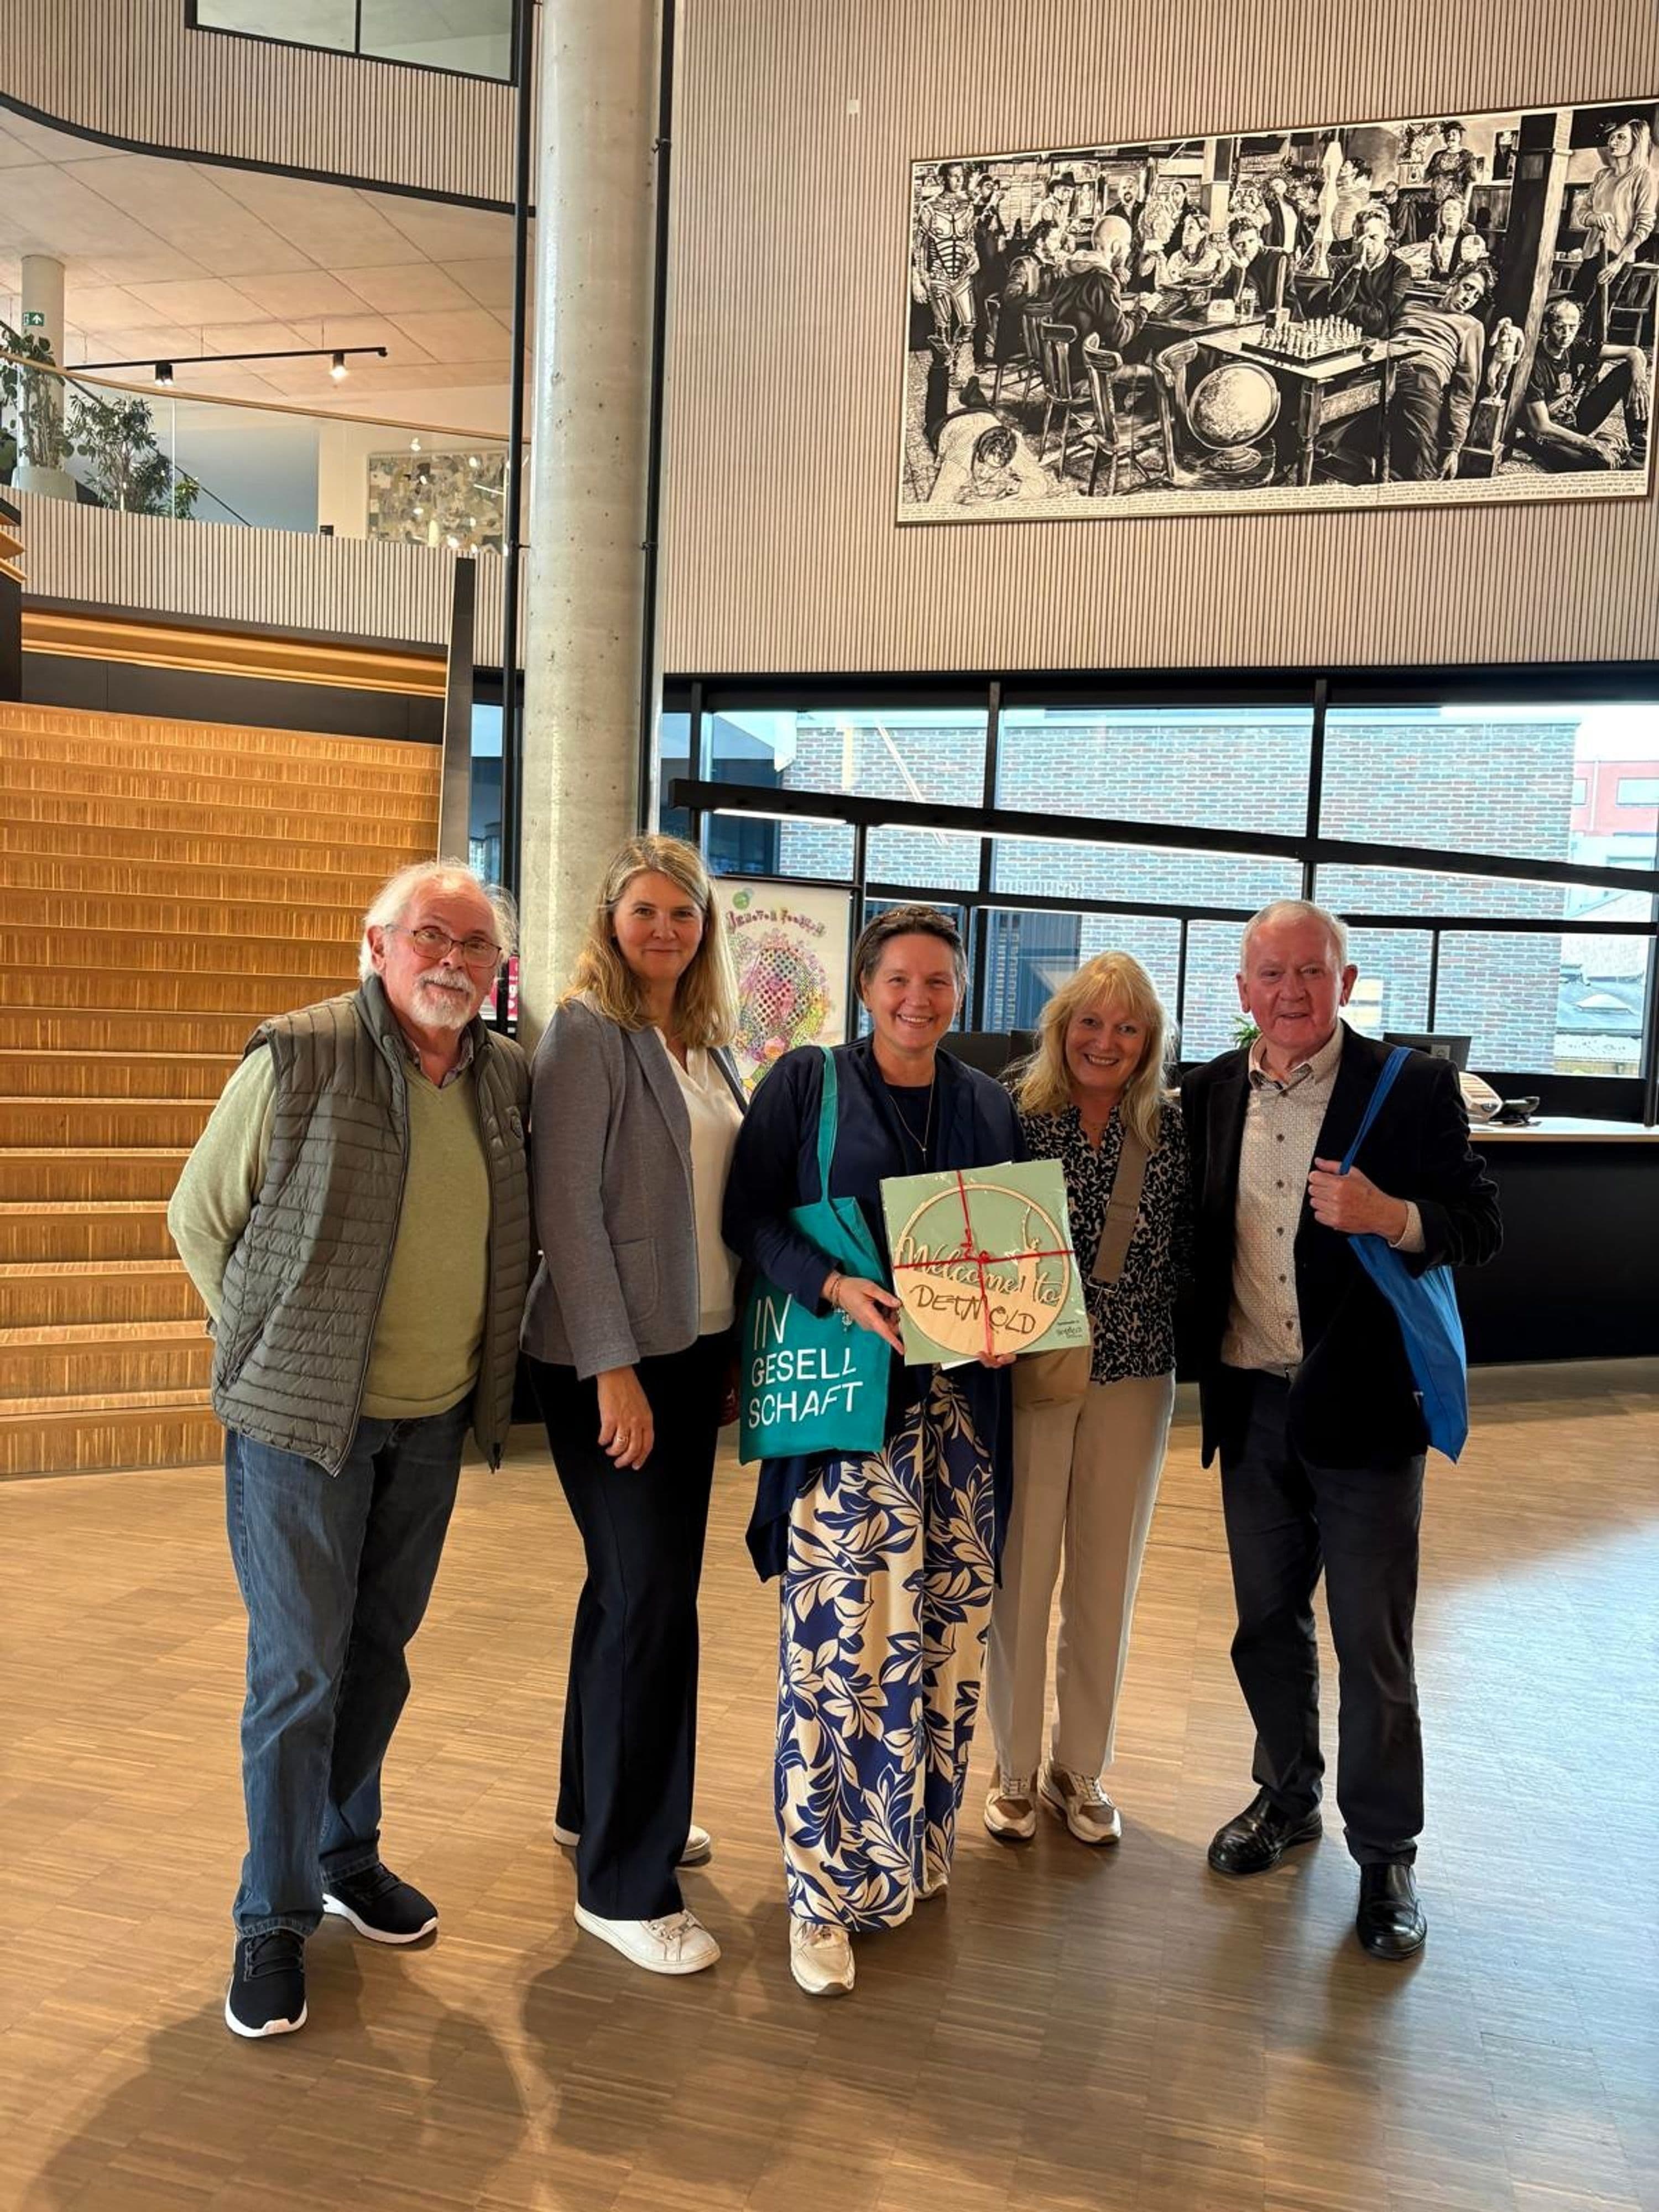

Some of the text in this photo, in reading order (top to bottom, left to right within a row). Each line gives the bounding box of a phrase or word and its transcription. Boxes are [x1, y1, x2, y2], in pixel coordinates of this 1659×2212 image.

[909, 1284, 1036, 1334] DETMOLD
[1035, 1271, 1062, 1304] to
[753, 1293, 792, 1350] IN
[751, 1347, 857, 1388] GESELL
[748, 1381, 864, 1430] SCHAFT
